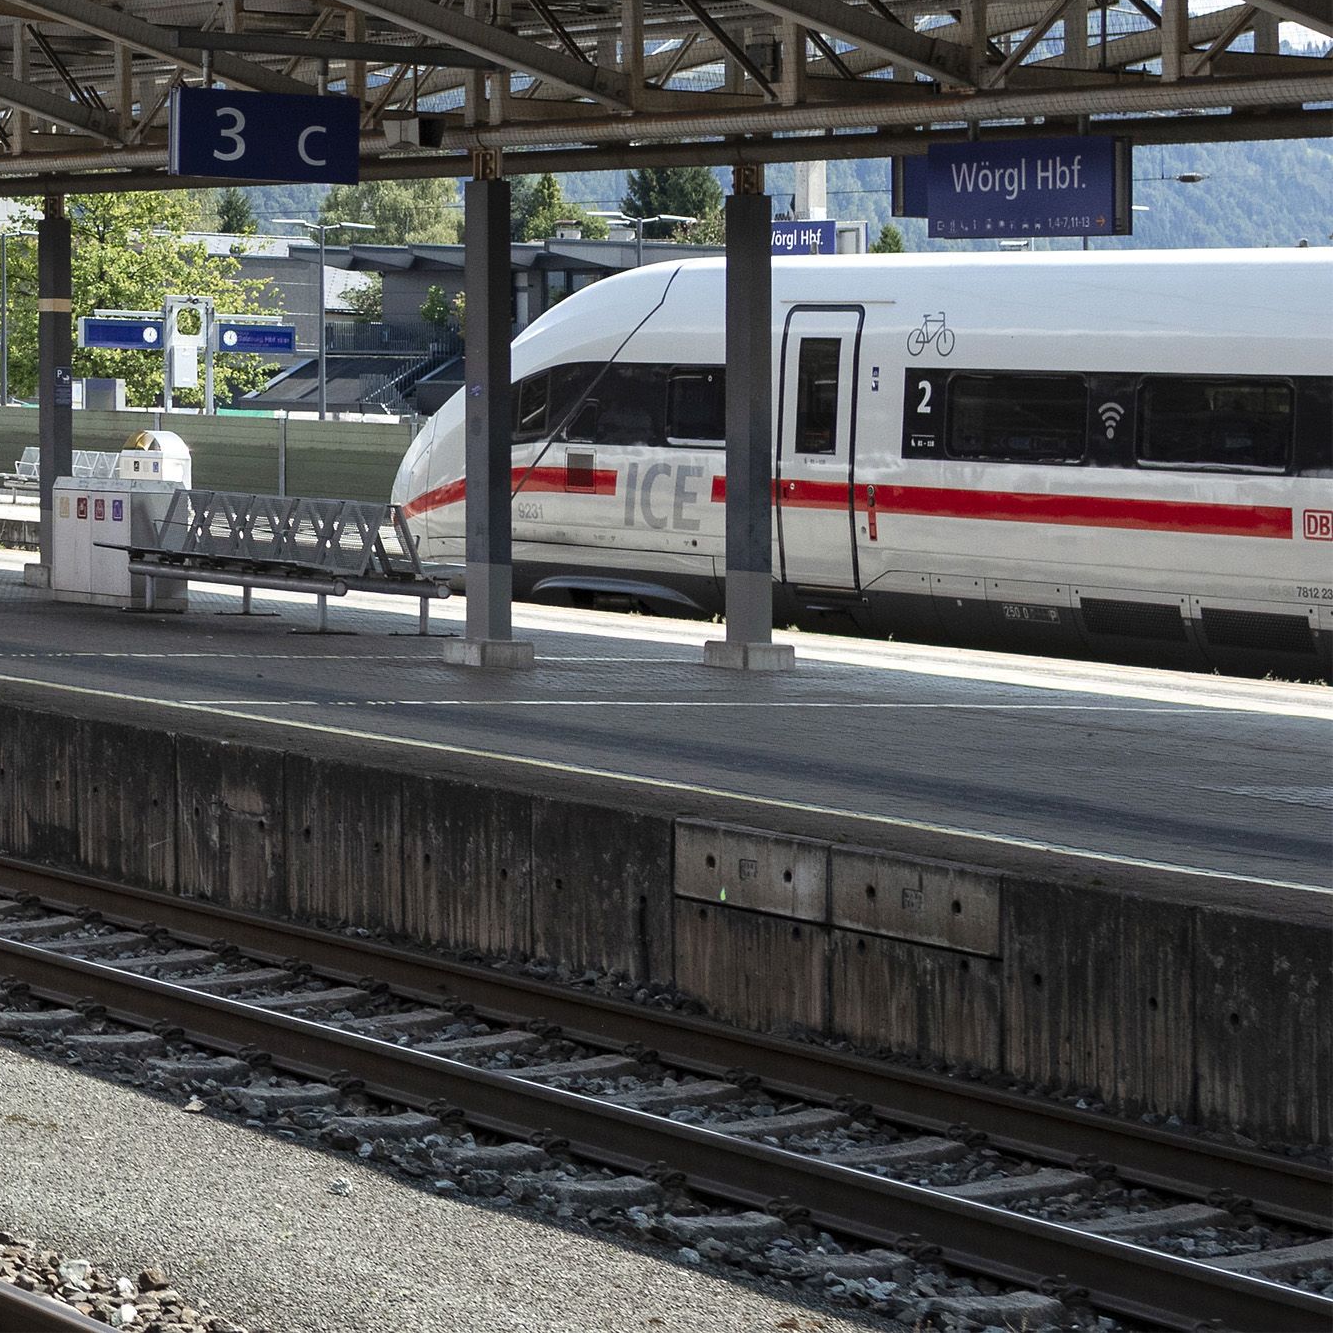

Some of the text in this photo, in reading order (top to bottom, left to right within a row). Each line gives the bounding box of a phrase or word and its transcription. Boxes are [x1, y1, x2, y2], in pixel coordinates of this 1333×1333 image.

[213, 107, 246, 161] 3
[952, 155, 1086, 200] Wörgl Hbf.
[917, 380, 933, 414] 2
[518, 503, 544, 519] 9231
[624, 462, 704, 531] ICE
[1307, 514, 1331, 537] DB
[1296, 586, 1320, 598] 7812
